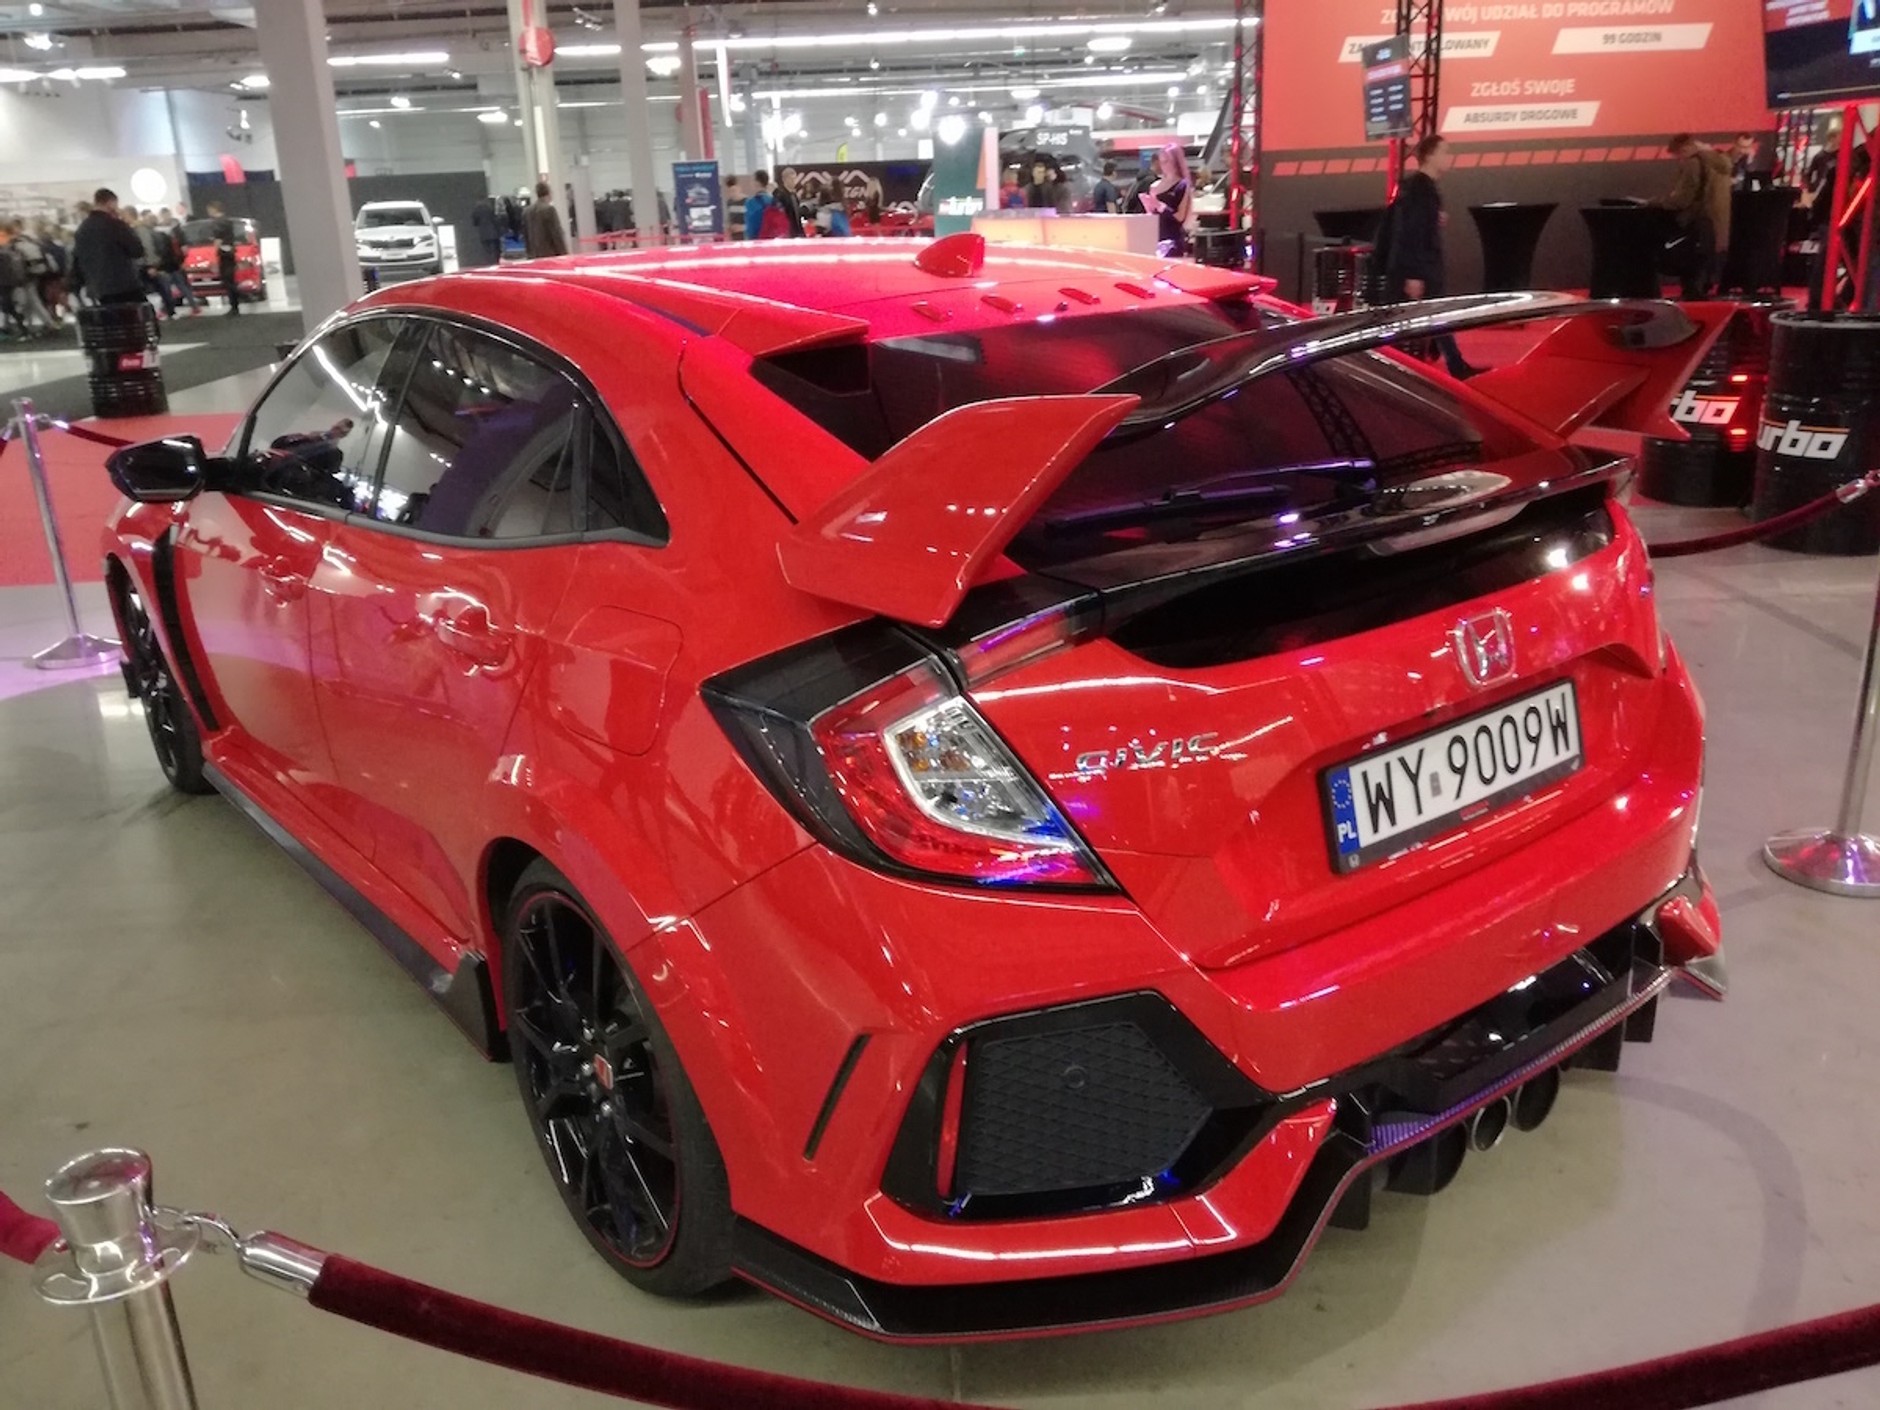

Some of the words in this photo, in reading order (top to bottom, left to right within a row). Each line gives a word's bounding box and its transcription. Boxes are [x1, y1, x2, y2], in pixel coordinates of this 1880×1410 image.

[1443, 4, 1478, 24] WÓJ
[1480, 4, 1538, 22] UDZIAŁ
[1541, 3, 1561, 18] DO
[1566, 0, 1674, 17] PROGRAMÓW
[1602, 33, 1616, 45] 99
[1618, 31, 1662, 44] GODZIN
[1470, 80, 1520, 97] ZGŁOŚ
[1524, 78, 1576, 97] SWOJE
[1464, 110, 1518, 125] ABSURDY
[1520, 108, 1578, 122] DROGOWE
[1757, 420, 1848, 459] urbo
[1361, 747, 1425, 835] WY
[1447, 692, 1571, 802] 9009W
[1337, 821, 1357, 843] PL
